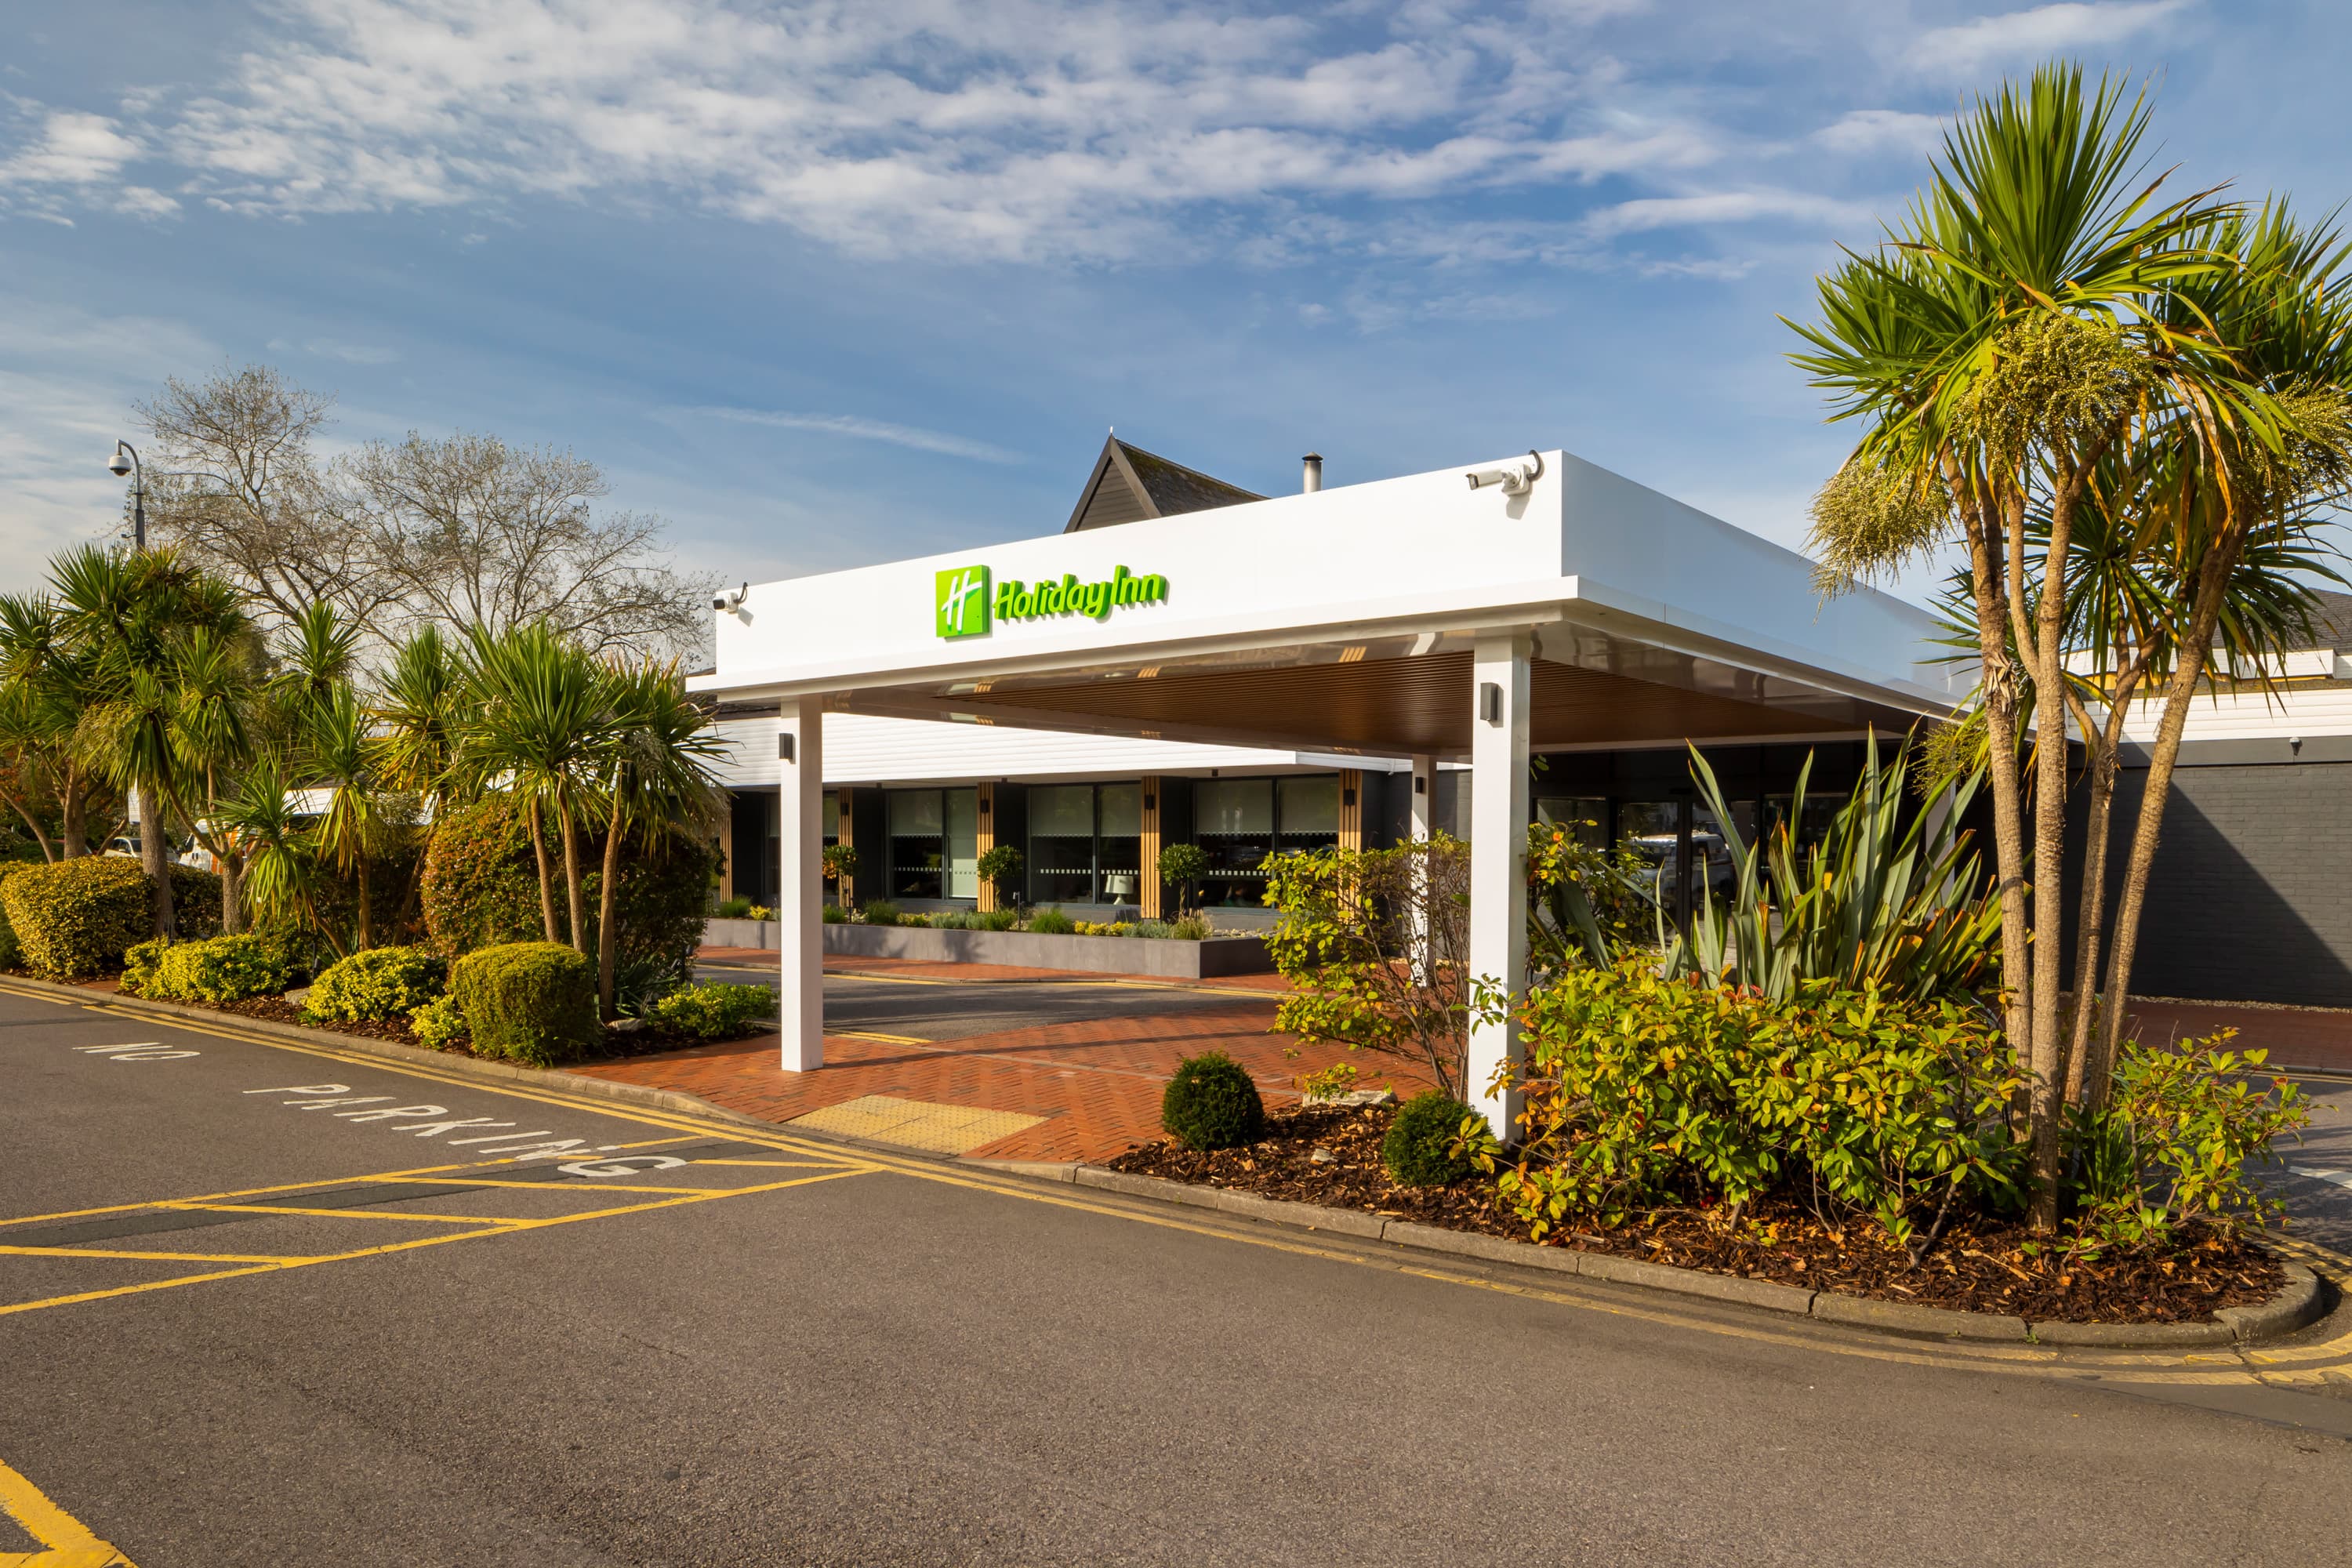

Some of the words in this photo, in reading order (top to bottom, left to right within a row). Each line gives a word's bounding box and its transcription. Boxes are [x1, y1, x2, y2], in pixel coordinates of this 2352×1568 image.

[993, 573, 1112, 620] Holiday
[1110, 564, 1167, 607] Inn
[71, 1041, 201, 1061] NO
[242, 1083, 690, 1177] PARKING
